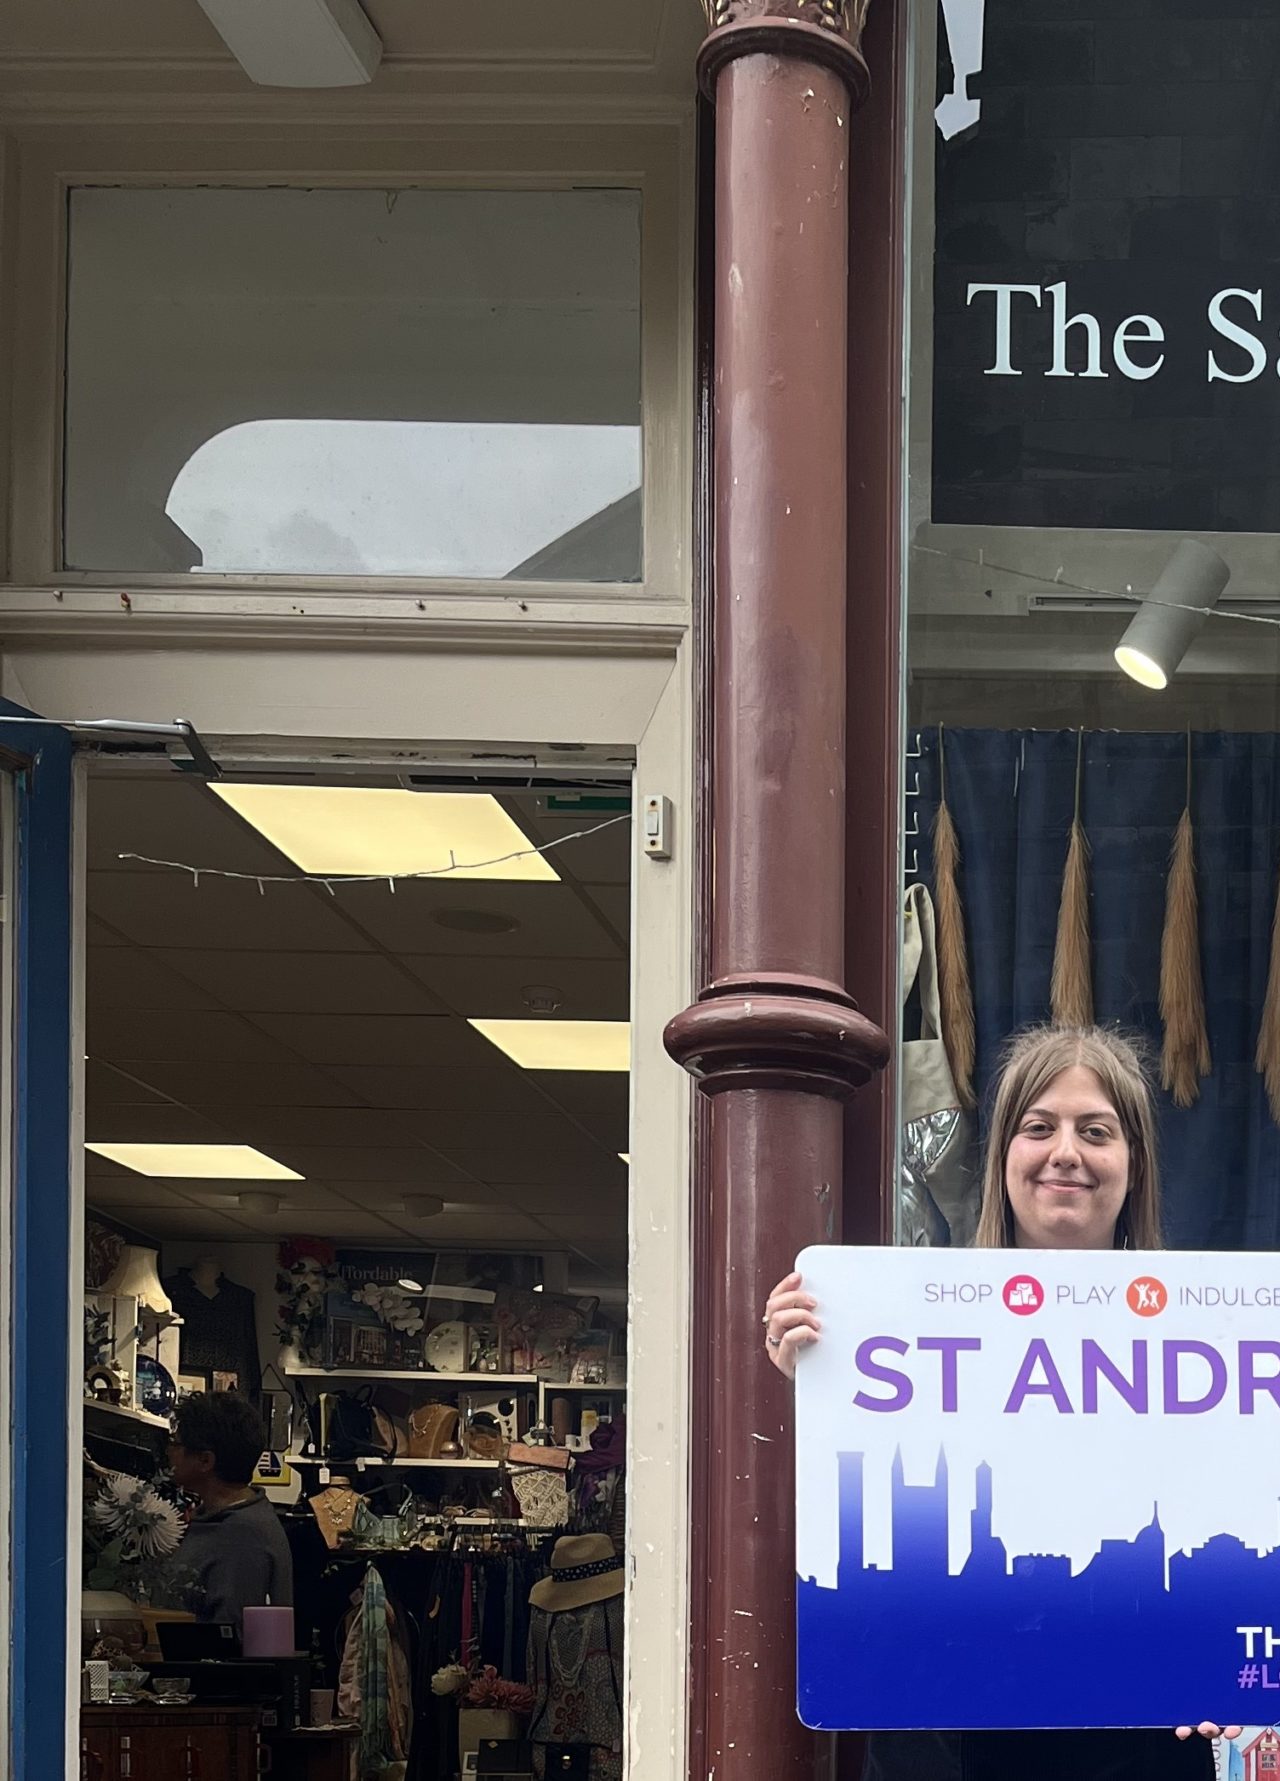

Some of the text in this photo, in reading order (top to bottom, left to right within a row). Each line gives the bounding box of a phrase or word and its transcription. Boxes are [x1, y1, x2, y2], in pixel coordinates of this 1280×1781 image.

[966, 281, 1165, 380] The
[331, 1264, 415, 1281] ffordable
[924, 1283, 993, 1303] SHOP
[1056, 1285, 1116, 1305] PLAY
[852, 1335, 982, 1413] ST
